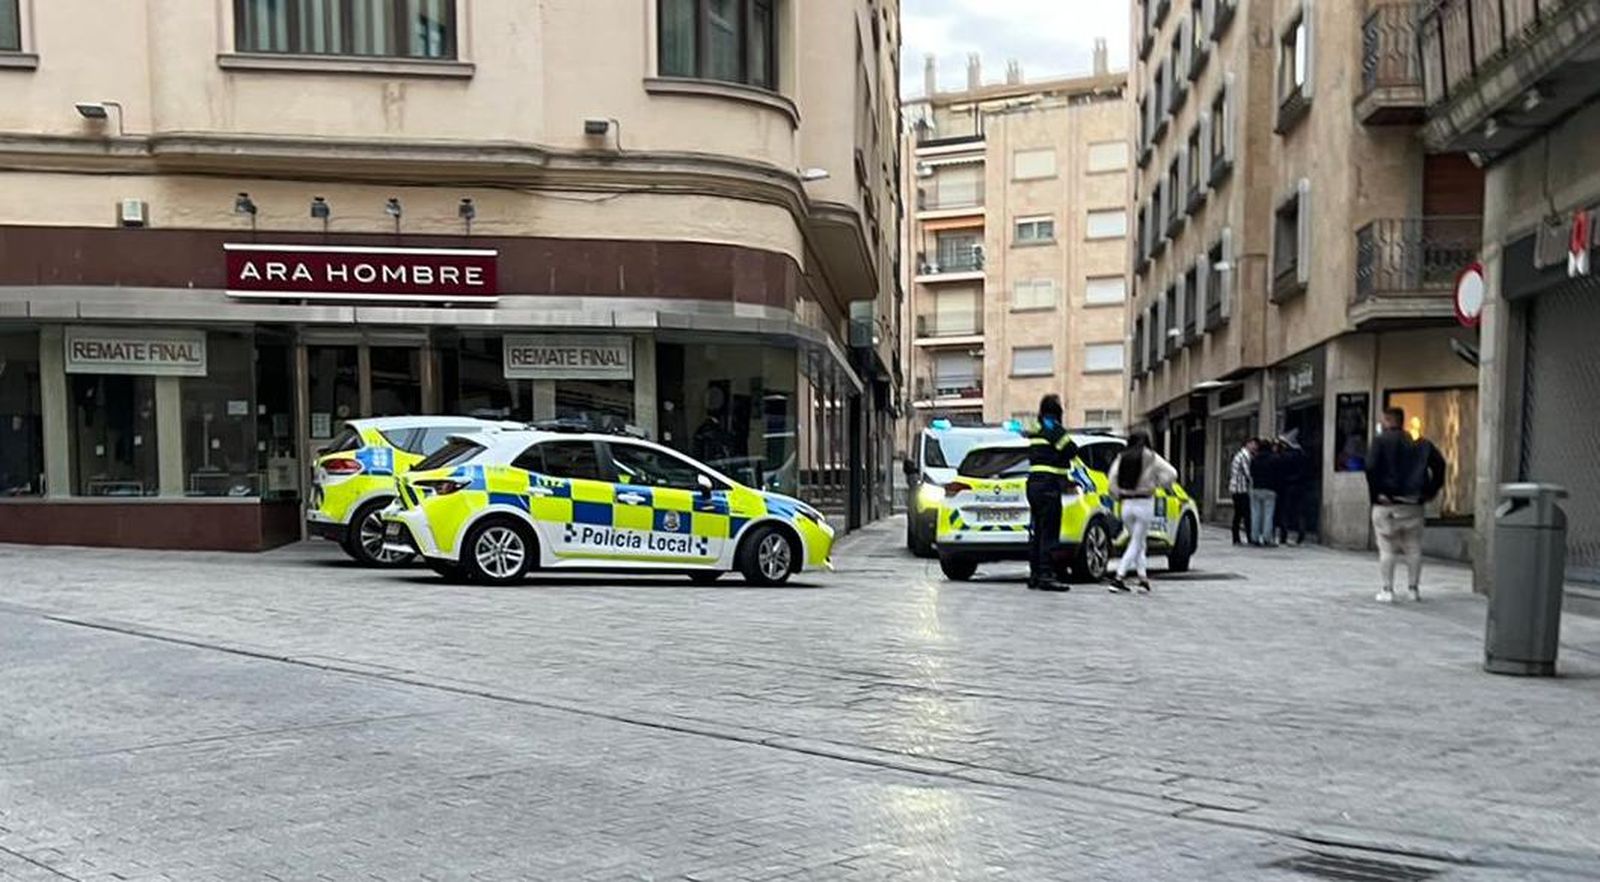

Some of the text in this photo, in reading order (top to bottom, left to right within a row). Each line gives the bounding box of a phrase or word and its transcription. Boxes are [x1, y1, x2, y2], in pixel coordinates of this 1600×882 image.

[239, 262, 485, 285] ARA HOMBRE
[73, 341, 200, 362] REMATE FINAL
[511, 347, 625, 367] REMATE FINAL
[582, 527, 693, 553] Policía Local
